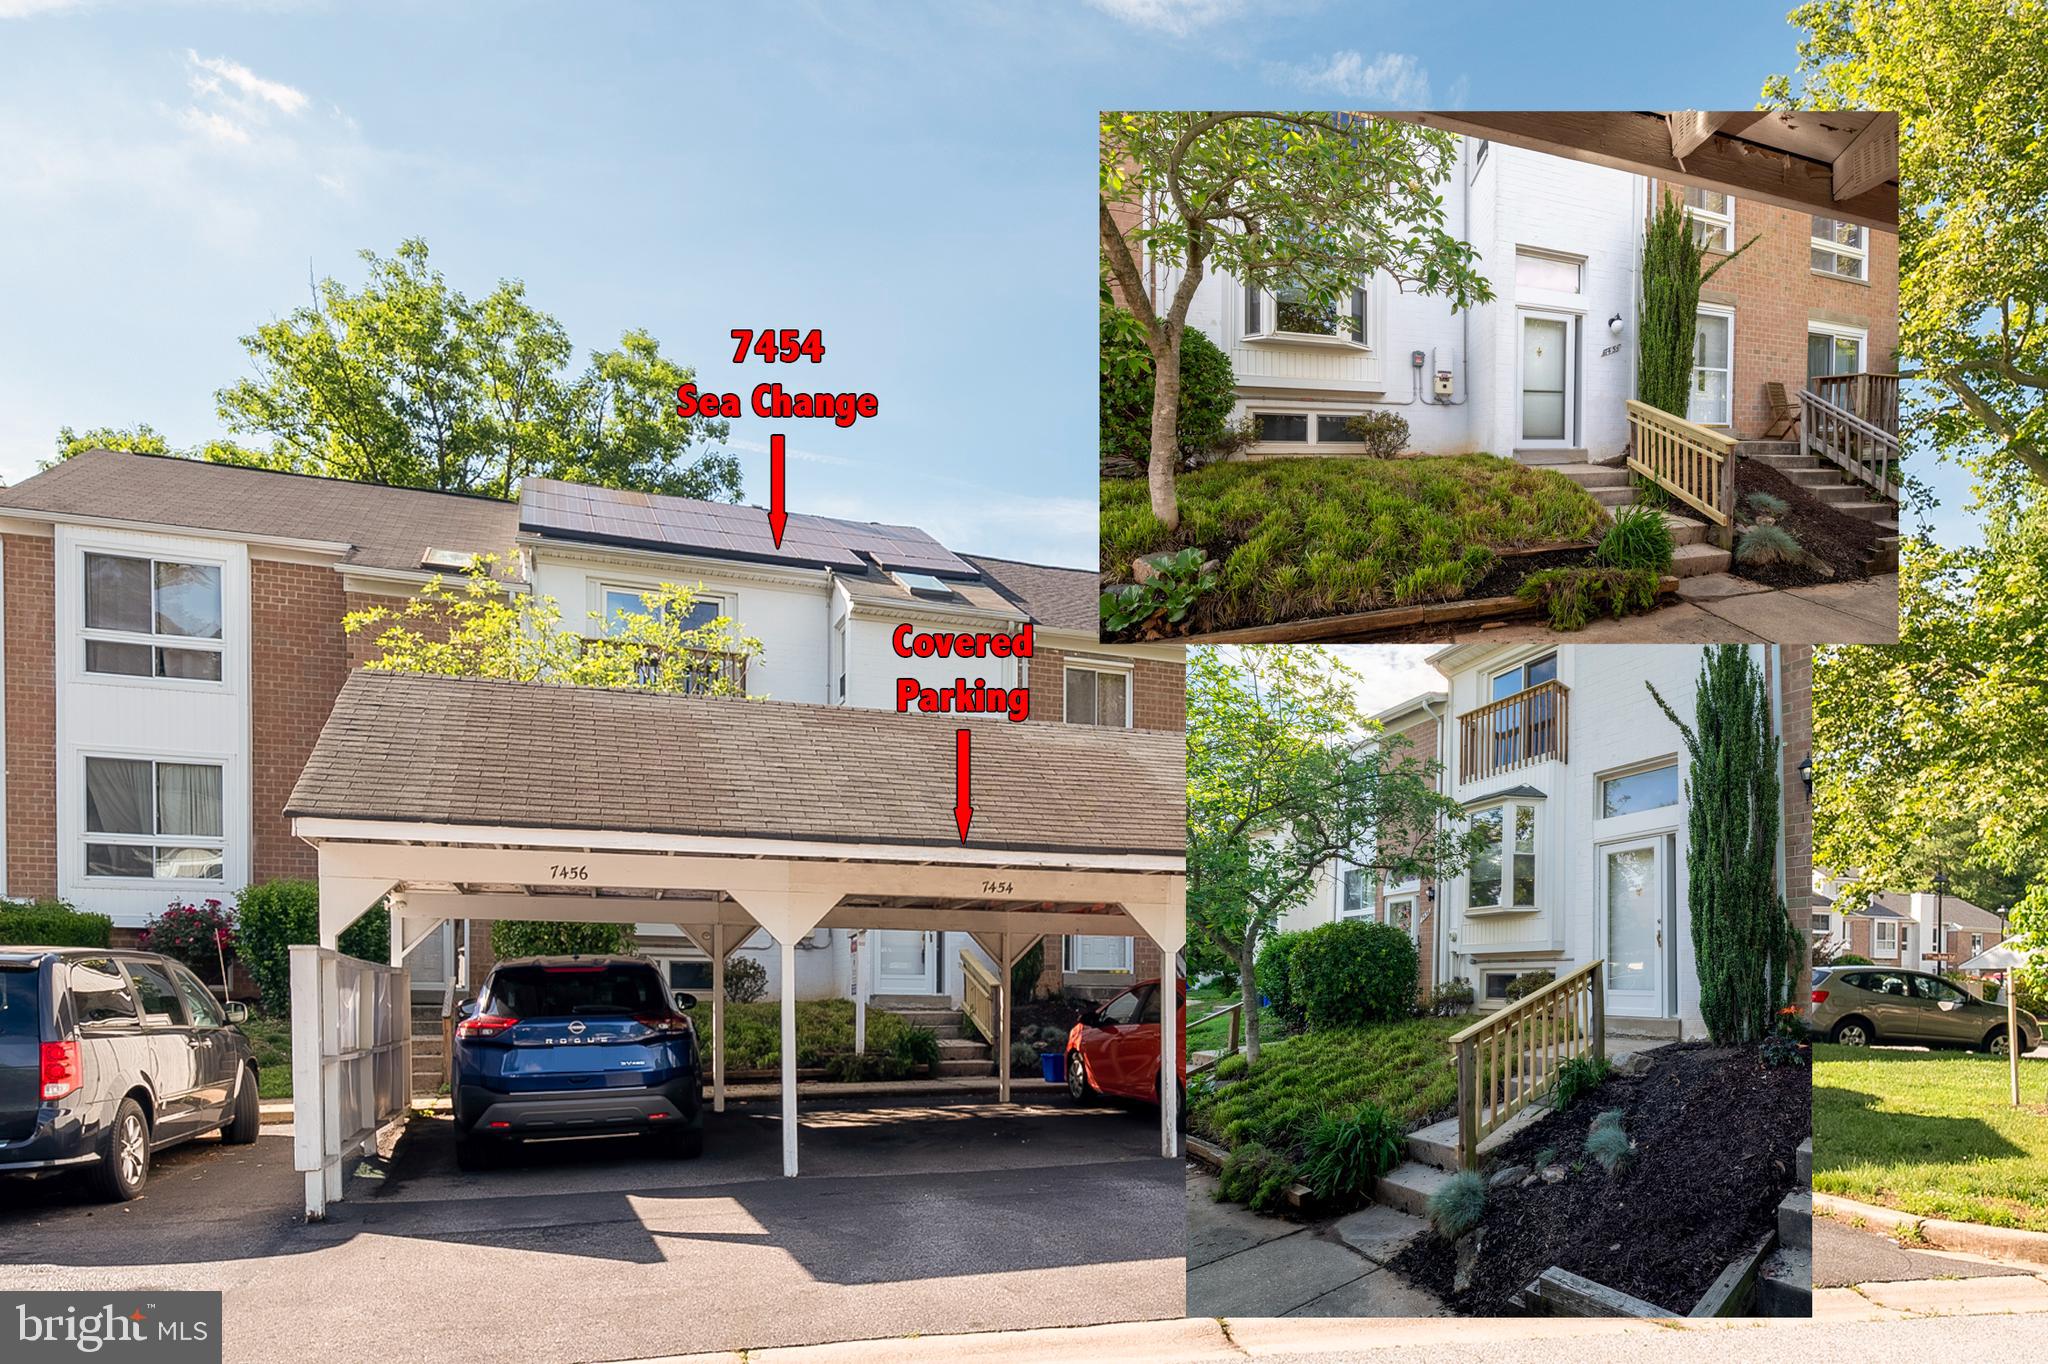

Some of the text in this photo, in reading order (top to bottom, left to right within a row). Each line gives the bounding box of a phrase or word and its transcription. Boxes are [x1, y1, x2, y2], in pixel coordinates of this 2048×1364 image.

[550, 865, 589, 880] 7456
[982, 881, 1013, 894] 7454
[545, 1036, 609, 1044] ROGUE
